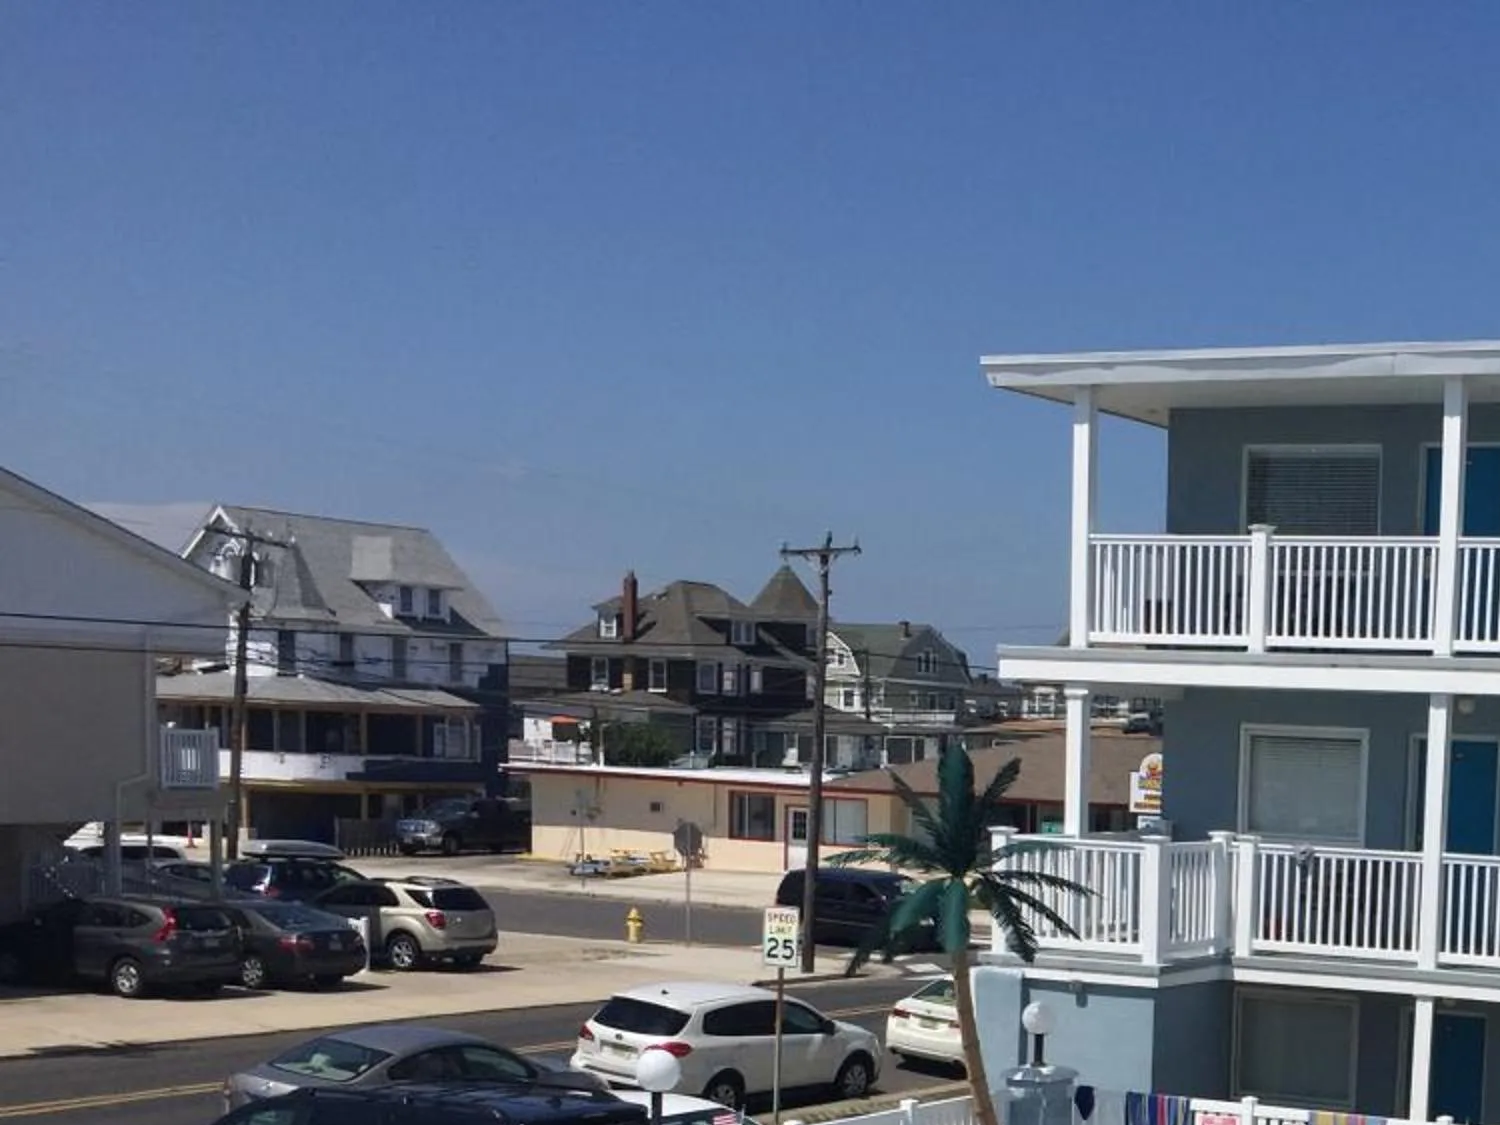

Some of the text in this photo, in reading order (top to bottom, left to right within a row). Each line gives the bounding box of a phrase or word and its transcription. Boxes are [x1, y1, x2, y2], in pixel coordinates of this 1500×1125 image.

[767, 911, 797, 925] SPEED
[769, 924, 793, 935] LIMIT
[766, 937, 795, 960] 25
